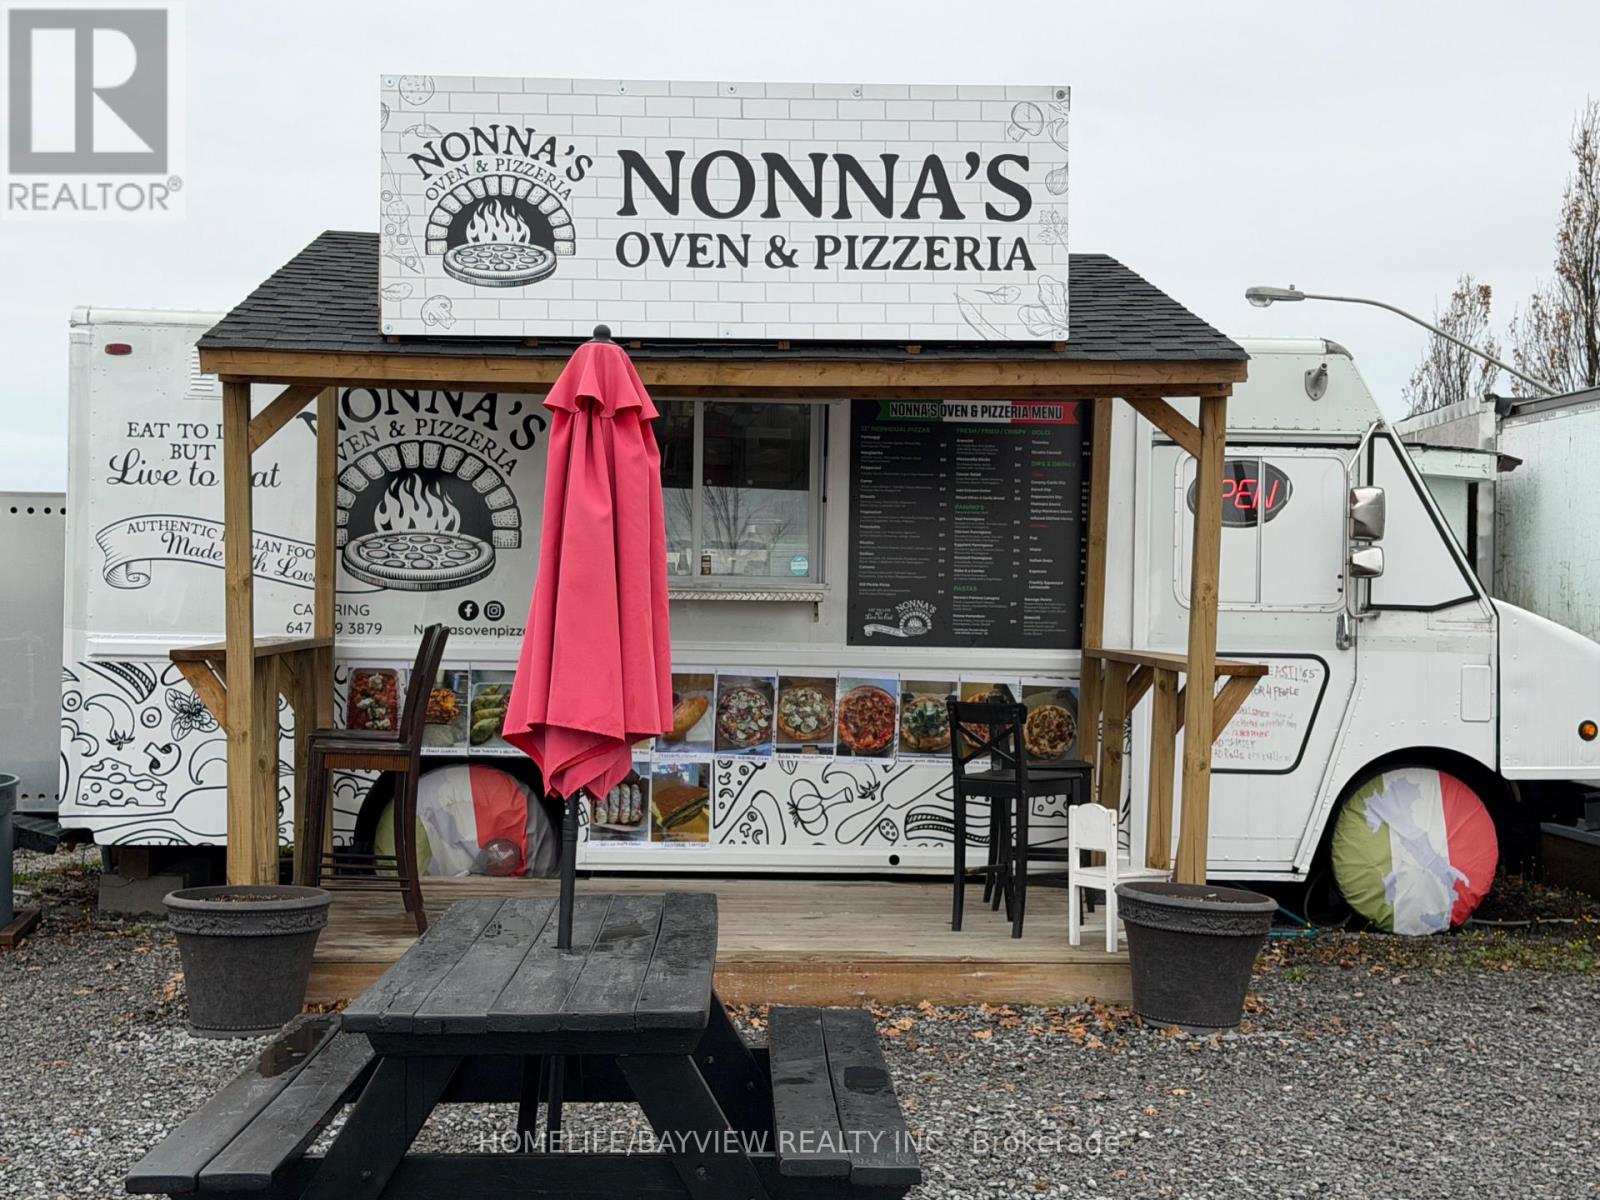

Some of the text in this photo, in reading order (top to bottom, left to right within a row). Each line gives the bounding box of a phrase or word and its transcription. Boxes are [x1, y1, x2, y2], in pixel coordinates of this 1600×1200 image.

[407, 124, 593, 182] NONNA'S
[425, 158, 572, 201] OVEN & PIZZERIA
[616, 149, 1033, 222] NONNA'S
[615, 231, 1037, 272] OVEN & PIZZERIA
[126, 421, 170, 439] EAT
[177, 423, 209, 440] TO
[890, 402, 937, 418] NONNA'S
[940, 403, 968, 418] OVEN
[980, 405, 1029, 419] PIZZERIA
[1031, 405, 1063, 420] MENU
[169, 443, 216, 461] BUT
[337, 418, 518, 477] VEN & PIZZERIA
[106, 448, 282, 488] Live to at
[1222, 479, 1279, 509] PEN
[126, 519, 218, 539] AUTHENTIC
[286, 544, 315, 560] FOO
[160, 531, 224, 561] Made
[274, 556, 315, 583] Lov
[286, 621, 312, 634] 647
[347, 622, 383, 635] 3879
[293, 603, 371, 617] CARING
